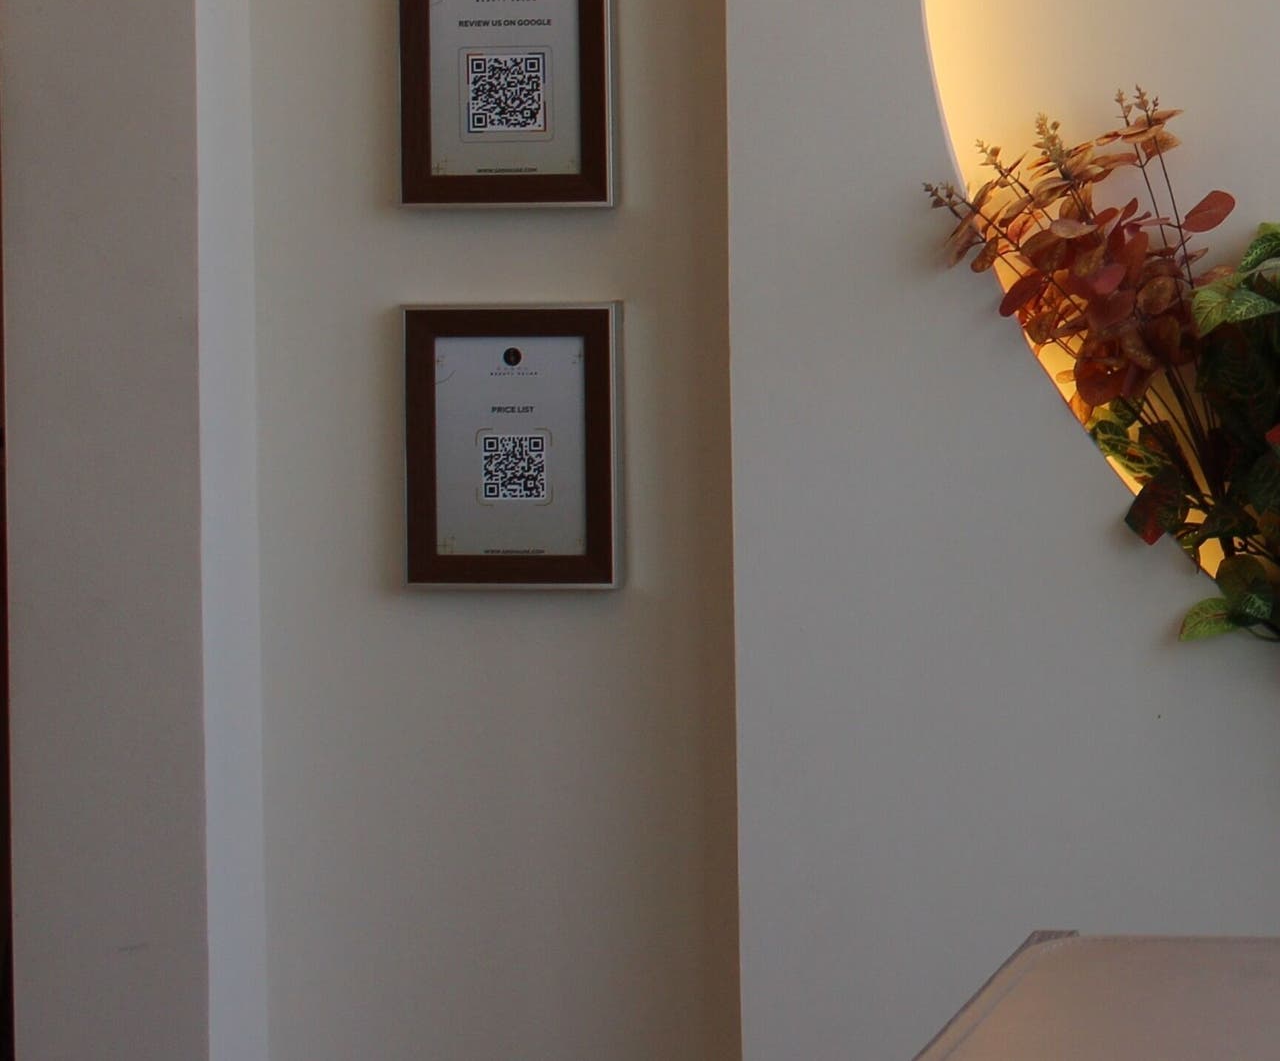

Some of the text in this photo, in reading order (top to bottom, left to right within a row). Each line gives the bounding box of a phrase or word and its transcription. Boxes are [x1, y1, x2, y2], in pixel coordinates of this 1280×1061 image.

[458, 18, 552, 28] REVIEW US ON GOOGLE
[491, 405, 535, 414] PRICE LIST
